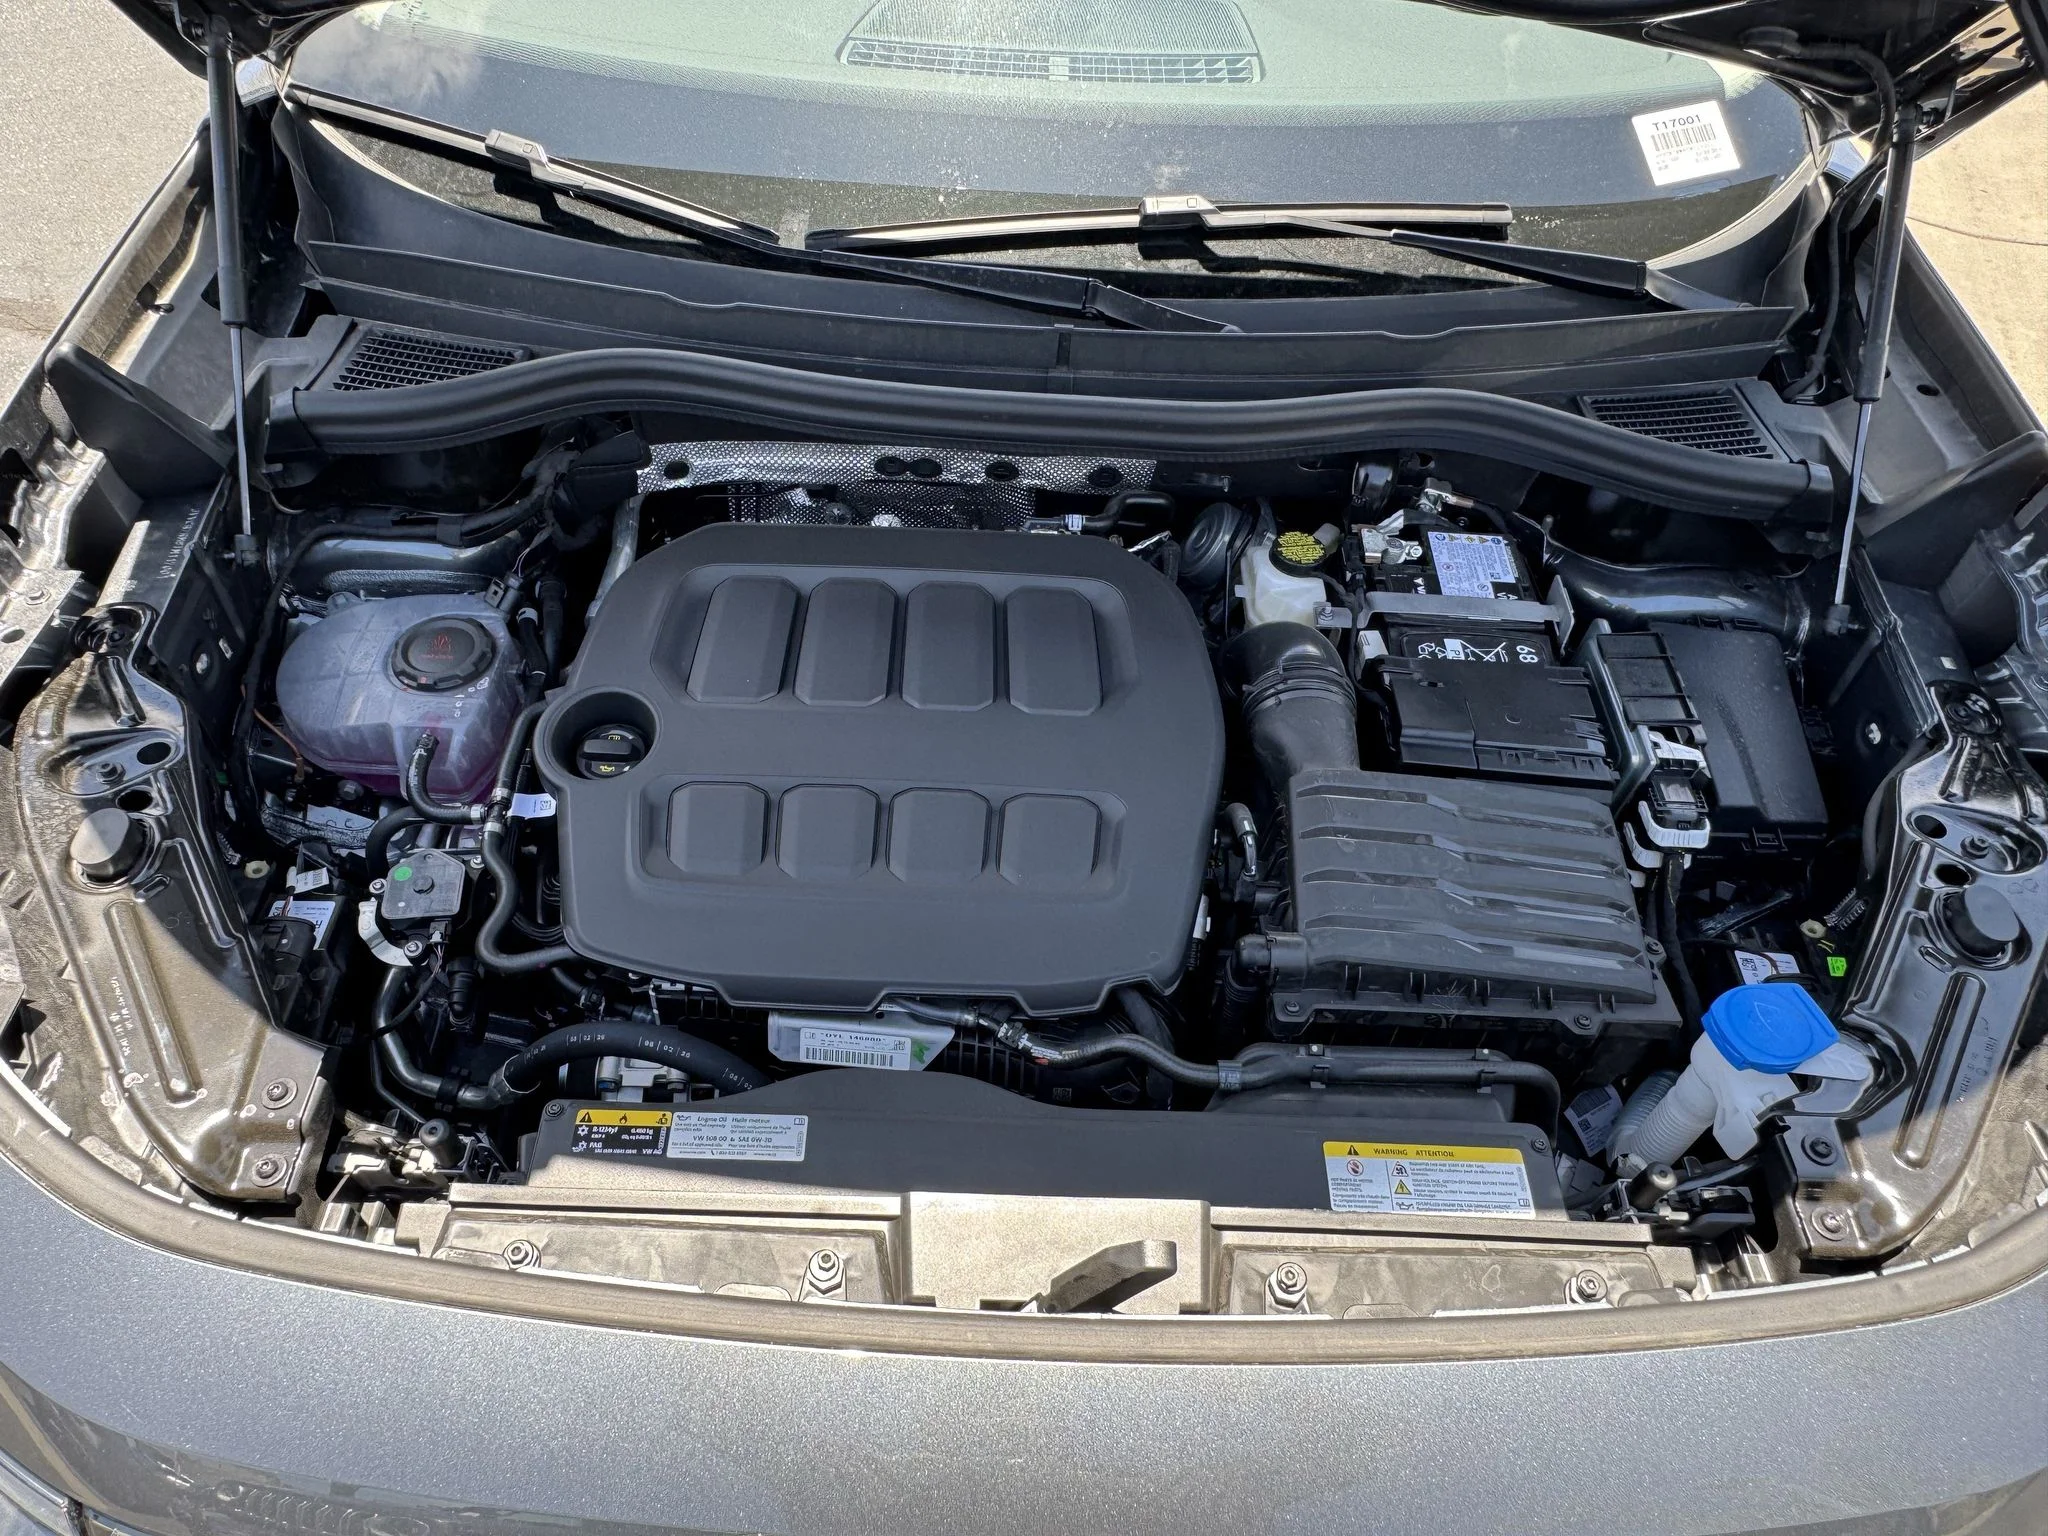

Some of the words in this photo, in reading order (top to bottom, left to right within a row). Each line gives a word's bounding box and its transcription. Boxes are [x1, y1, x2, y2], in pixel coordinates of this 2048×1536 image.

[1652, 114, 1701, 131] T17001
[1516, 645, 1539, 664] 68
[1373, 1148, 1408, 1156] WARNING
[1416, 1150, 1454, 1158] ATTENTION
